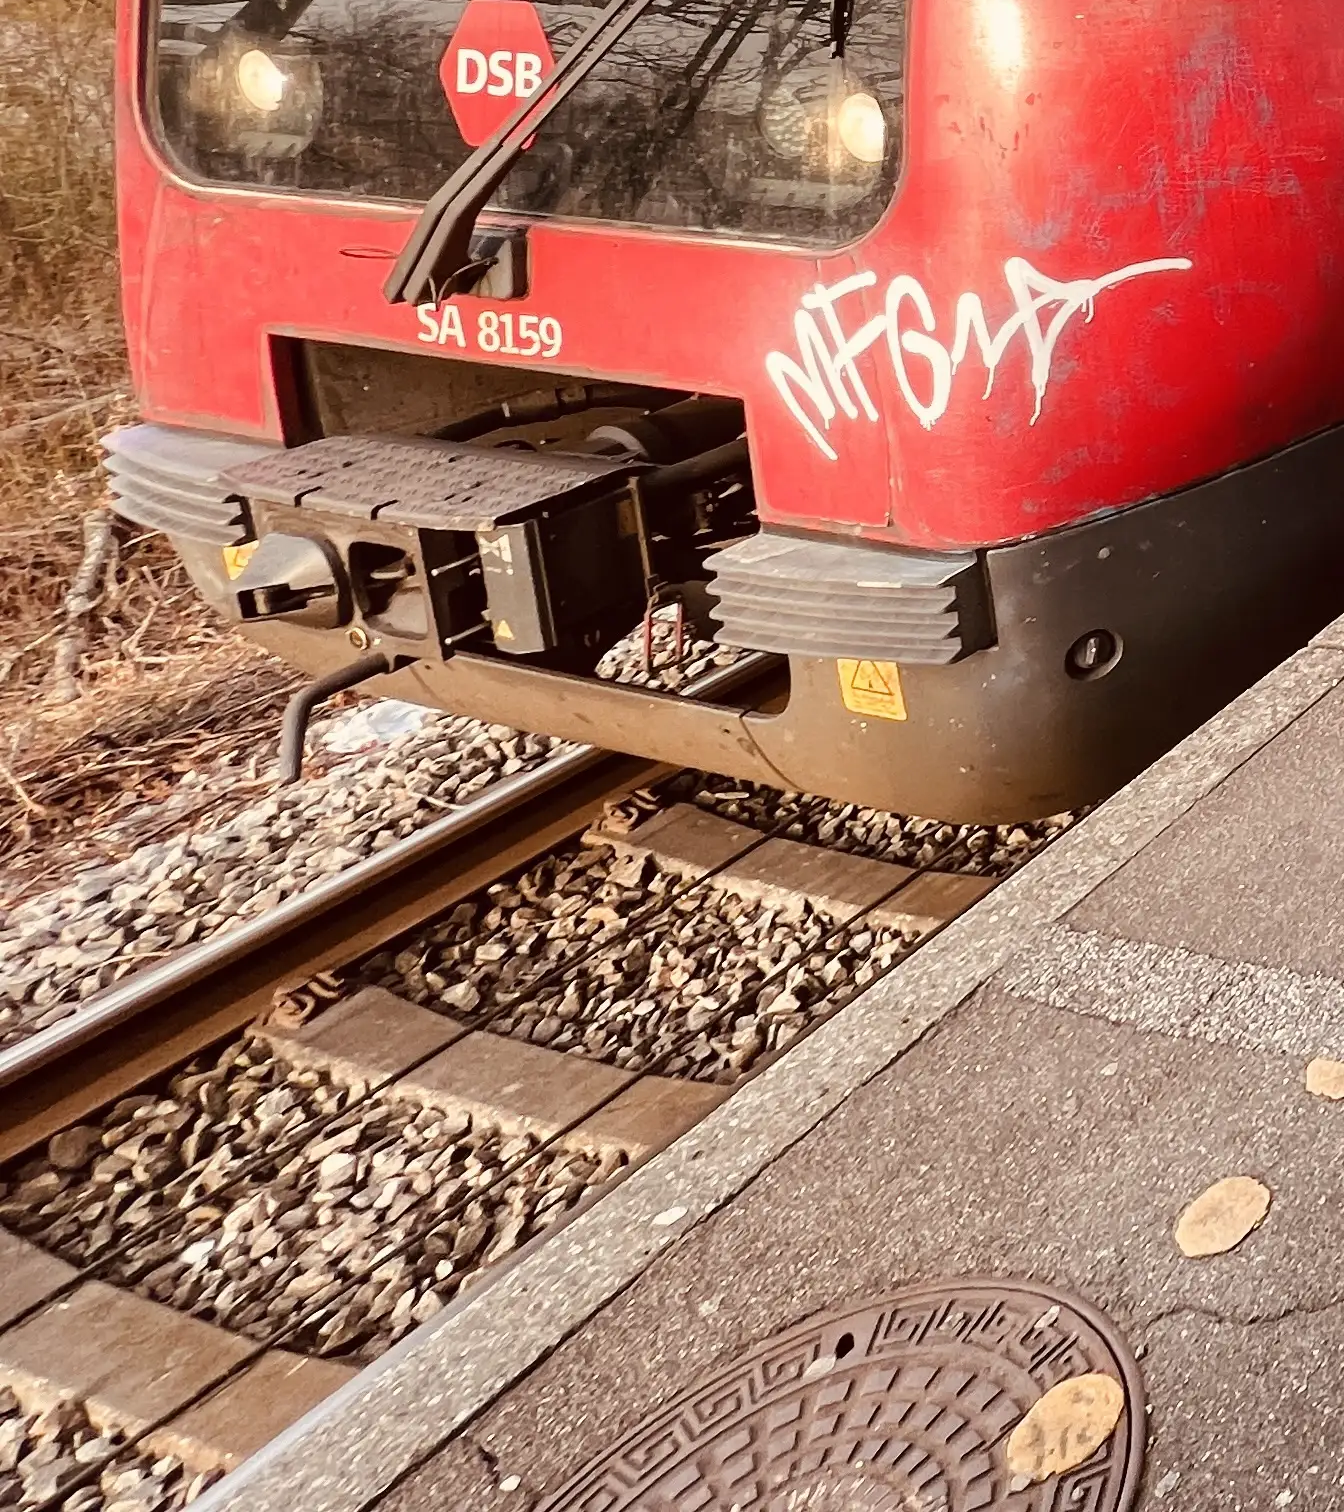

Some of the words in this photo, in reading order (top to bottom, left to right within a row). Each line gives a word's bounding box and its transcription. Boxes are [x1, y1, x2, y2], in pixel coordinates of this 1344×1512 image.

[456, 48, 543, 98] DSB
[417, 303, 466, 347] SA
[477, 311, 562, 358] 8159
